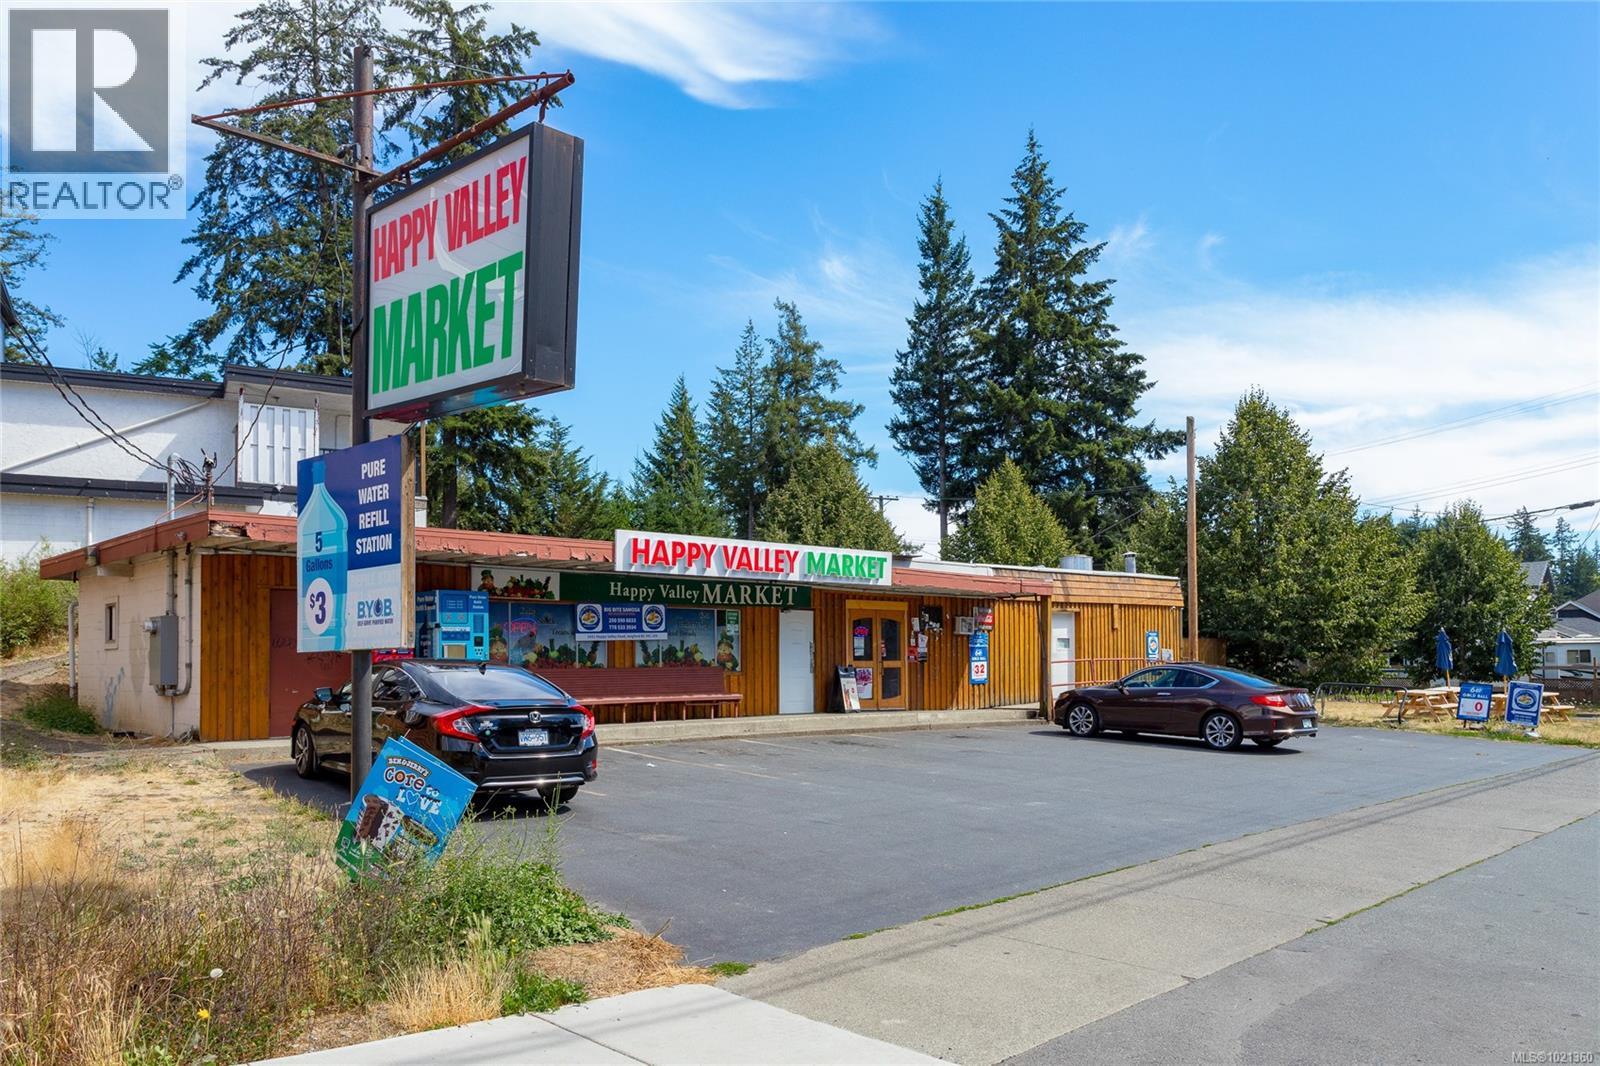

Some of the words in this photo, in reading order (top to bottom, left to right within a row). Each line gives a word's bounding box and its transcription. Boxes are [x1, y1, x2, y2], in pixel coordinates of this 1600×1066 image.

[374, 200, 438, 282] HAPPY
[445, 156, 527, 252] VALLEY
[372, 251, 523, 395] MARKET
[361, 458, 386, 480] PURE
[358, 483, 389, 505] WATER
[359, 509, 389, 530] REFILL
[315, 531, 323, 553] 5
[355, 533, 392, 555] STATION
[306, 559, 333, 573] Gallons
[631, 537, 716, 569] HAPPY
[722, 545, 800, 575] VALLEY
[806, 551, 888, 580] MARKET
[609, 581, 655, 603] Happy
[659, 584, 700, 603] Valley
[702, 583, 798, 606] MARKET
[309, 591, 326, 625] $3
[974, 664, 985, 674] 32
[384, 767, 425, 791] Core
